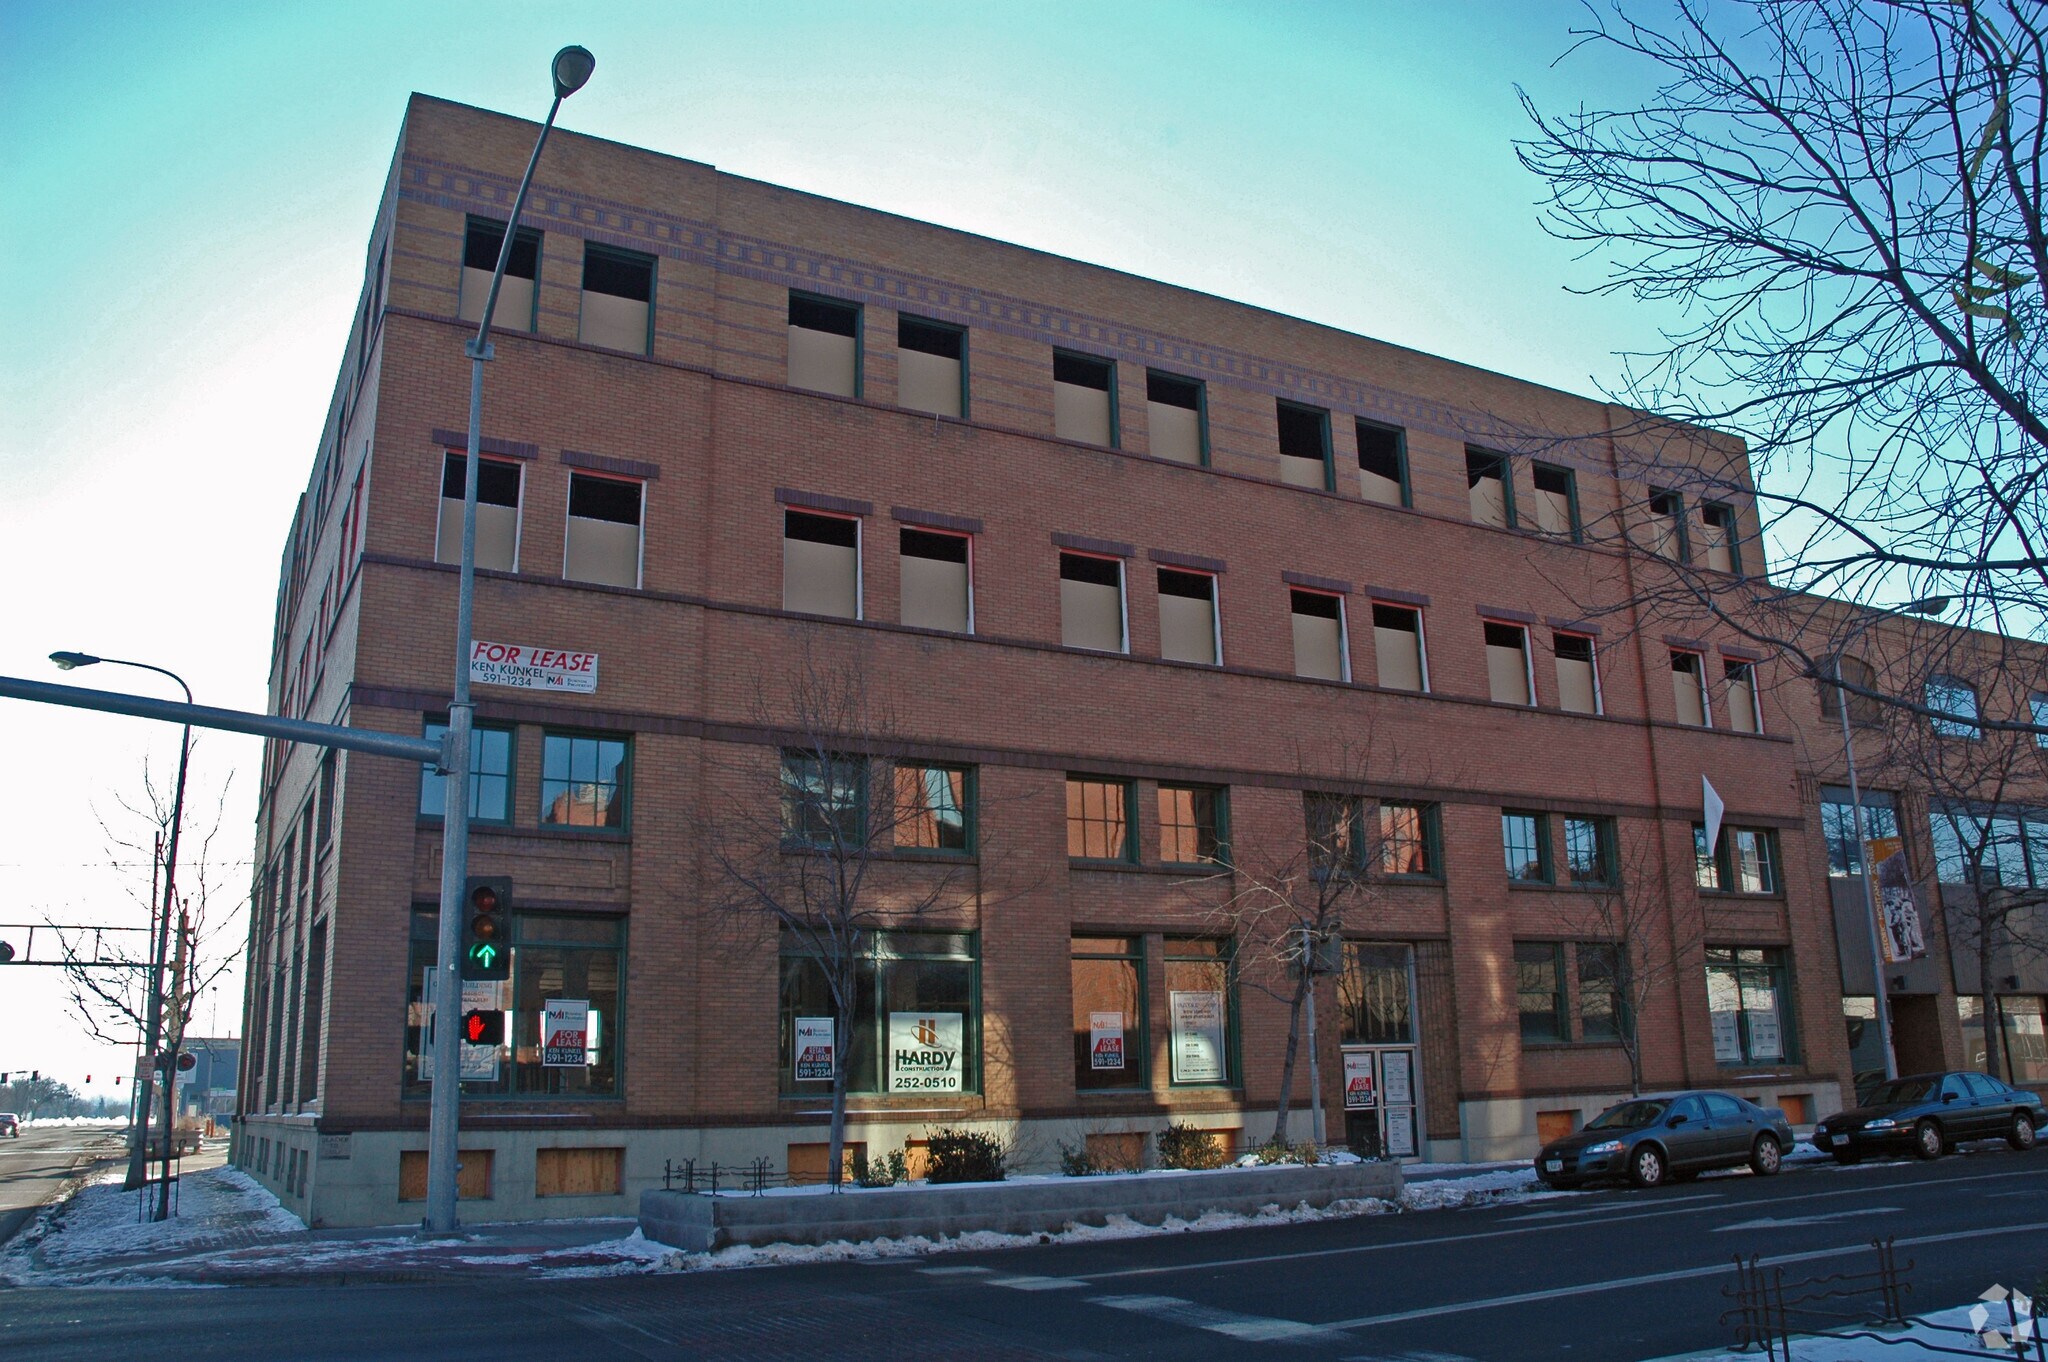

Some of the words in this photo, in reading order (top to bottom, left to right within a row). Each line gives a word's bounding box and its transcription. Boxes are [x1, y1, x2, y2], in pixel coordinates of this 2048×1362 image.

[473, 641, 521, 664] FOR
[530, 650, 595, 672] LEASE
[471, 661, 495, 672] KEN
[500, 665, 544, 678] KUNKEL
[483, 673, 532, 686] 591-1234
[547, 675, 564, 685] NAI
[1874, 880, 1885, 920] MONTANA
[549, 1009, 564, 1019] NAI
[560, 1031, 578, 1039] FOR
[799, 1026, 813, 1036] NAI
[556, 1038, 582, 1047] LEASE
[809, 1046, 824, 1054] RETAIL
[547, 1054, 583, 1063] 591-1234
[803, 1054, 814, 1062] FOR
[816, 1054, 831, 1062] LEASE
[895, 1049, 956, 1071] HARDY
[1094, 1058, 1121, 1066] 591-1234
[799, 1069, 831, 1077] 591-1234
[895, 1077, 956, 1088] 252-0510
[1348, 1095, 1371, 1103] 591-1234
